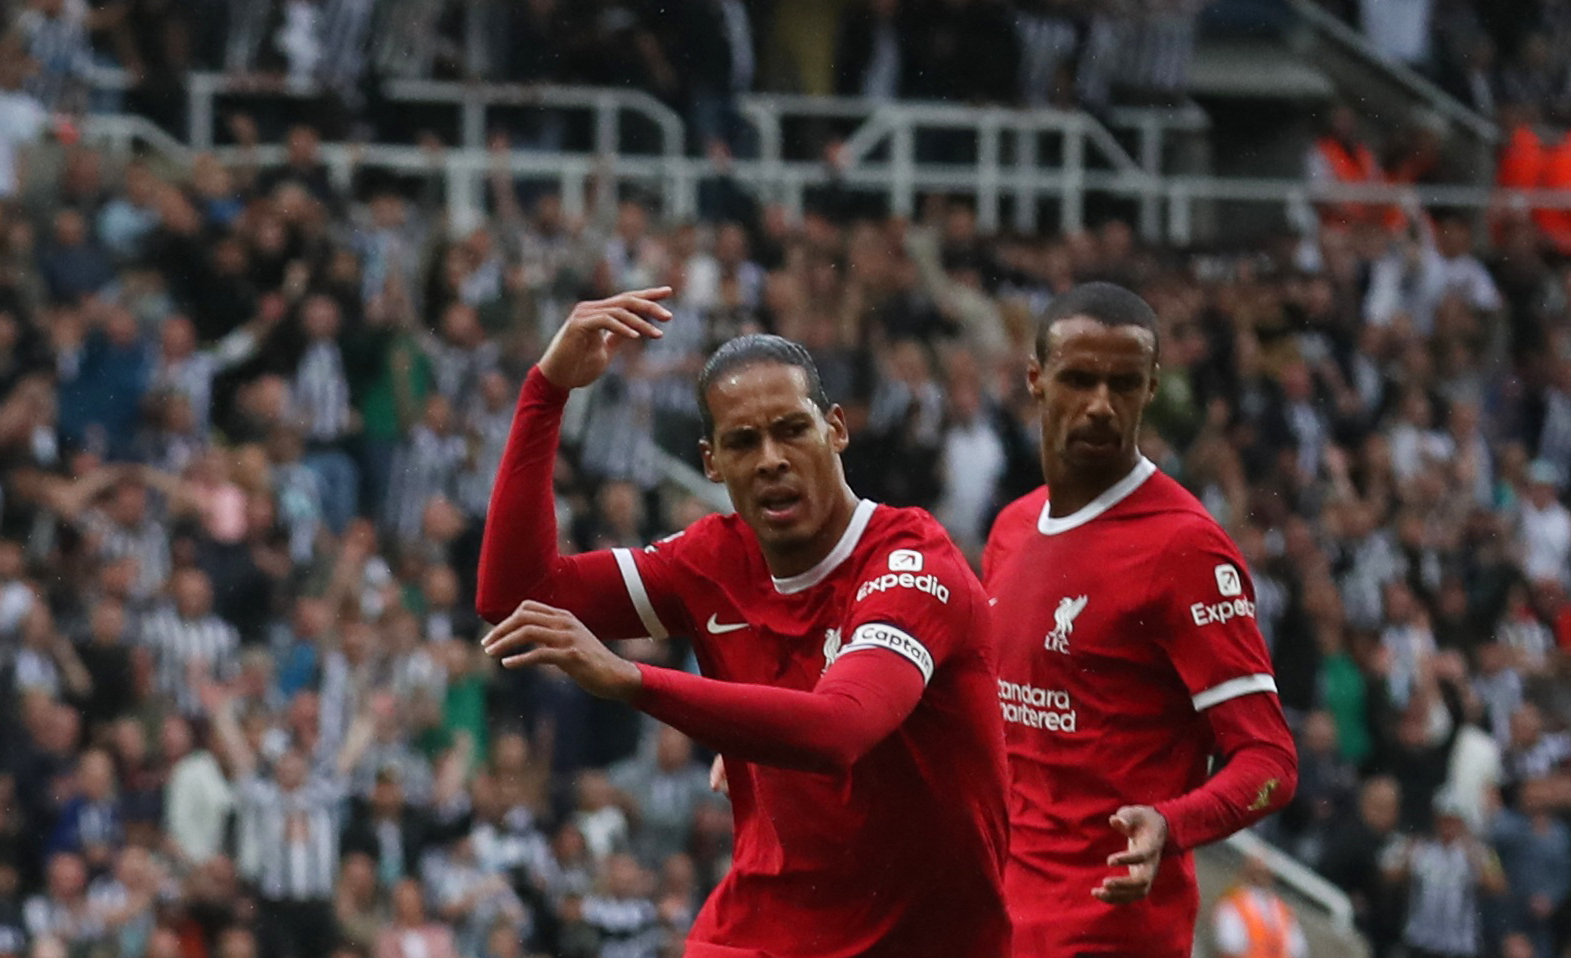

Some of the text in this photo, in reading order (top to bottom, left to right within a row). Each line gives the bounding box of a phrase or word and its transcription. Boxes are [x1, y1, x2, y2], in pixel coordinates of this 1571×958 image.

[856, 573, 950, 604] Expedia
[997, 676, 1070, 709] andard
[1000, 702, 1076, 732] artered
